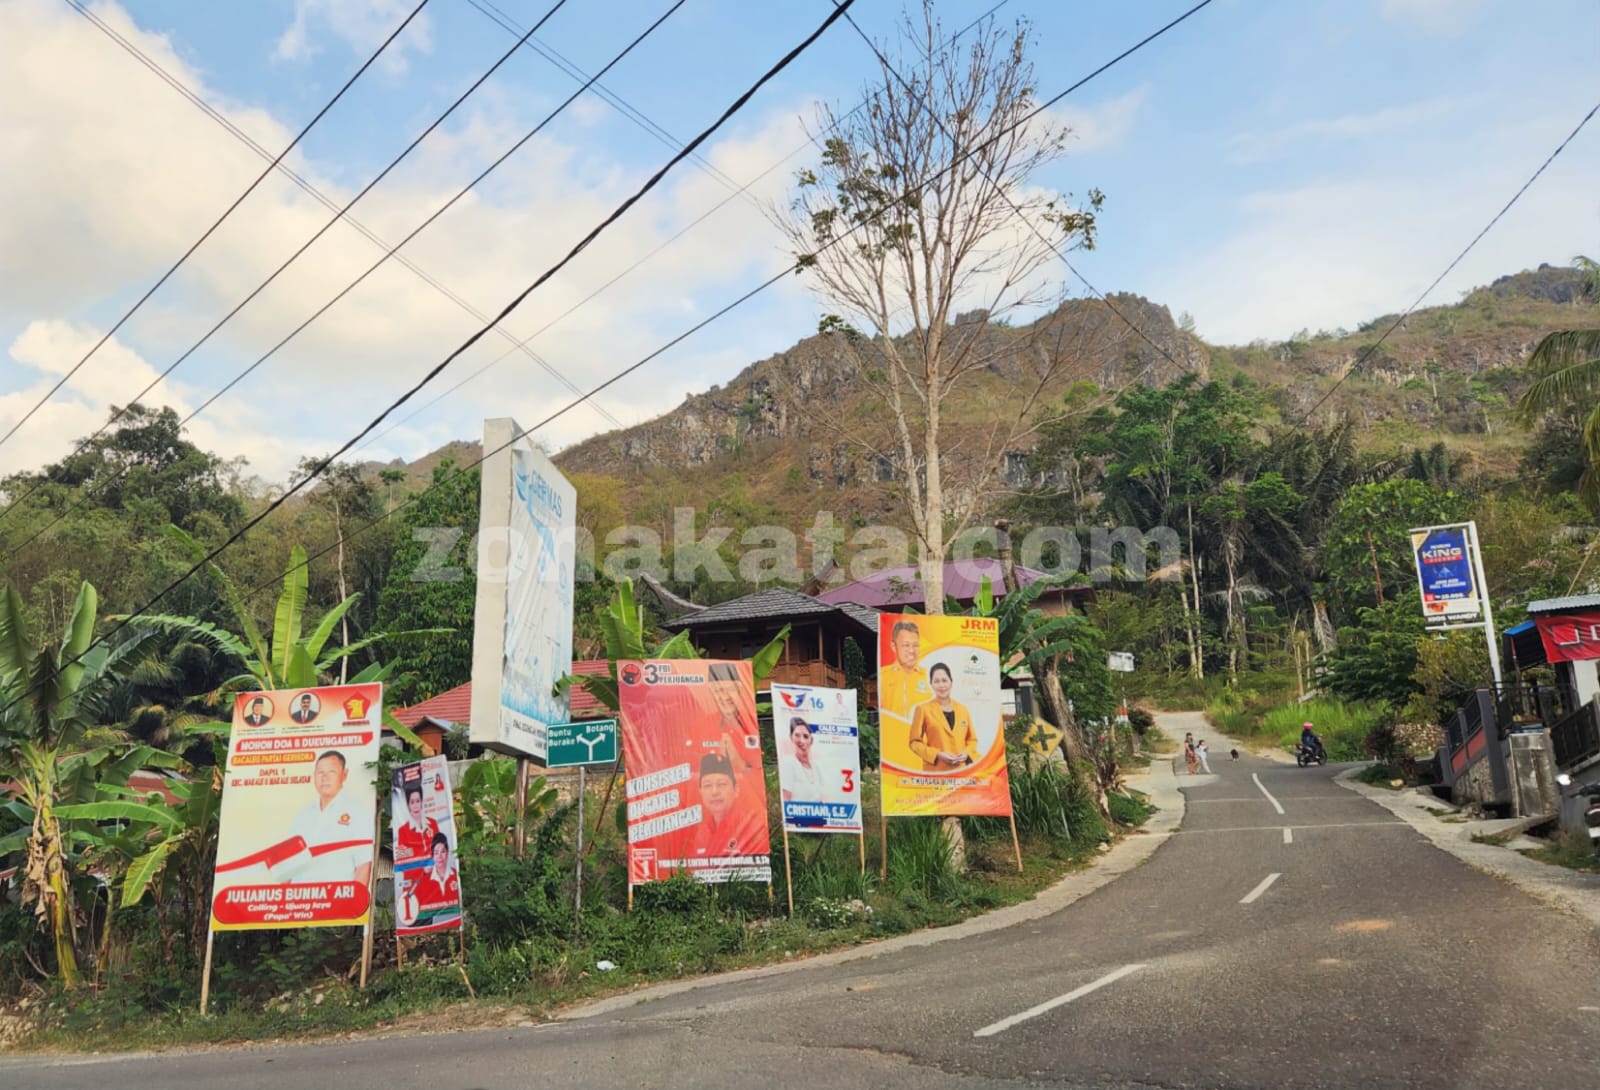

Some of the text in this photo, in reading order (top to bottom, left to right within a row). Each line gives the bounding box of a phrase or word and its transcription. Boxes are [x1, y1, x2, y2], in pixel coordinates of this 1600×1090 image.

[1422, 548, 1461, 559] KING
[961, 619, 996, 630] JRM
[644, 664, 659, 684] 3
[810, 697, 824, 709] 16
[549, 729, 572, 738] Buntu
[241, 738, 273, 751] MOHON
[275, 737, 293, 749] DOA
[549, 738, 576, 747] Burake
[841, 770, 854, 793] 3
[225, 889, 283, 903] JULIANUS
[334, 885, 354, 898] ARI
